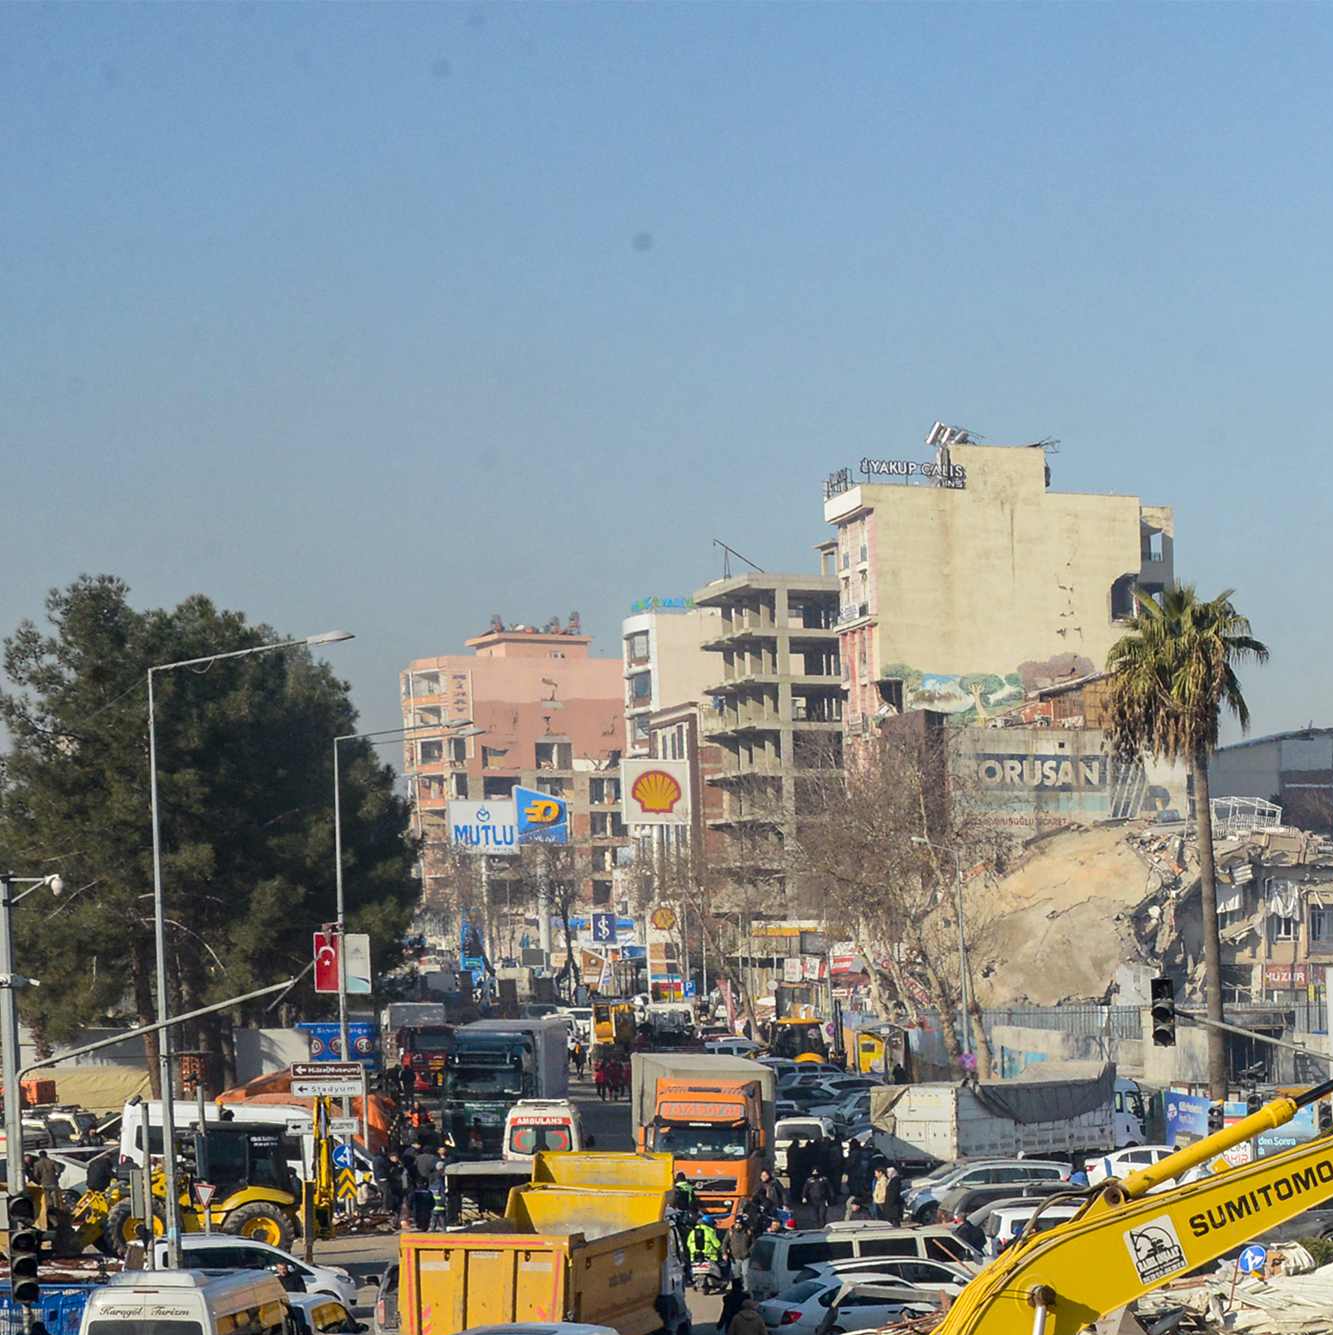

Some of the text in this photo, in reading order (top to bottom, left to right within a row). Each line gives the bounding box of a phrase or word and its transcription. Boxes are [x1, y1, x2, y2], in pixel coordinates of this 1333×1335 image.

[871, 460, 916, 475] YAKUP
[454, 824, 514, 846] MUTLU
[311, 1086, 357, 1094] Stadyum
[517, 1117, 564, 1126] AMBULANS
